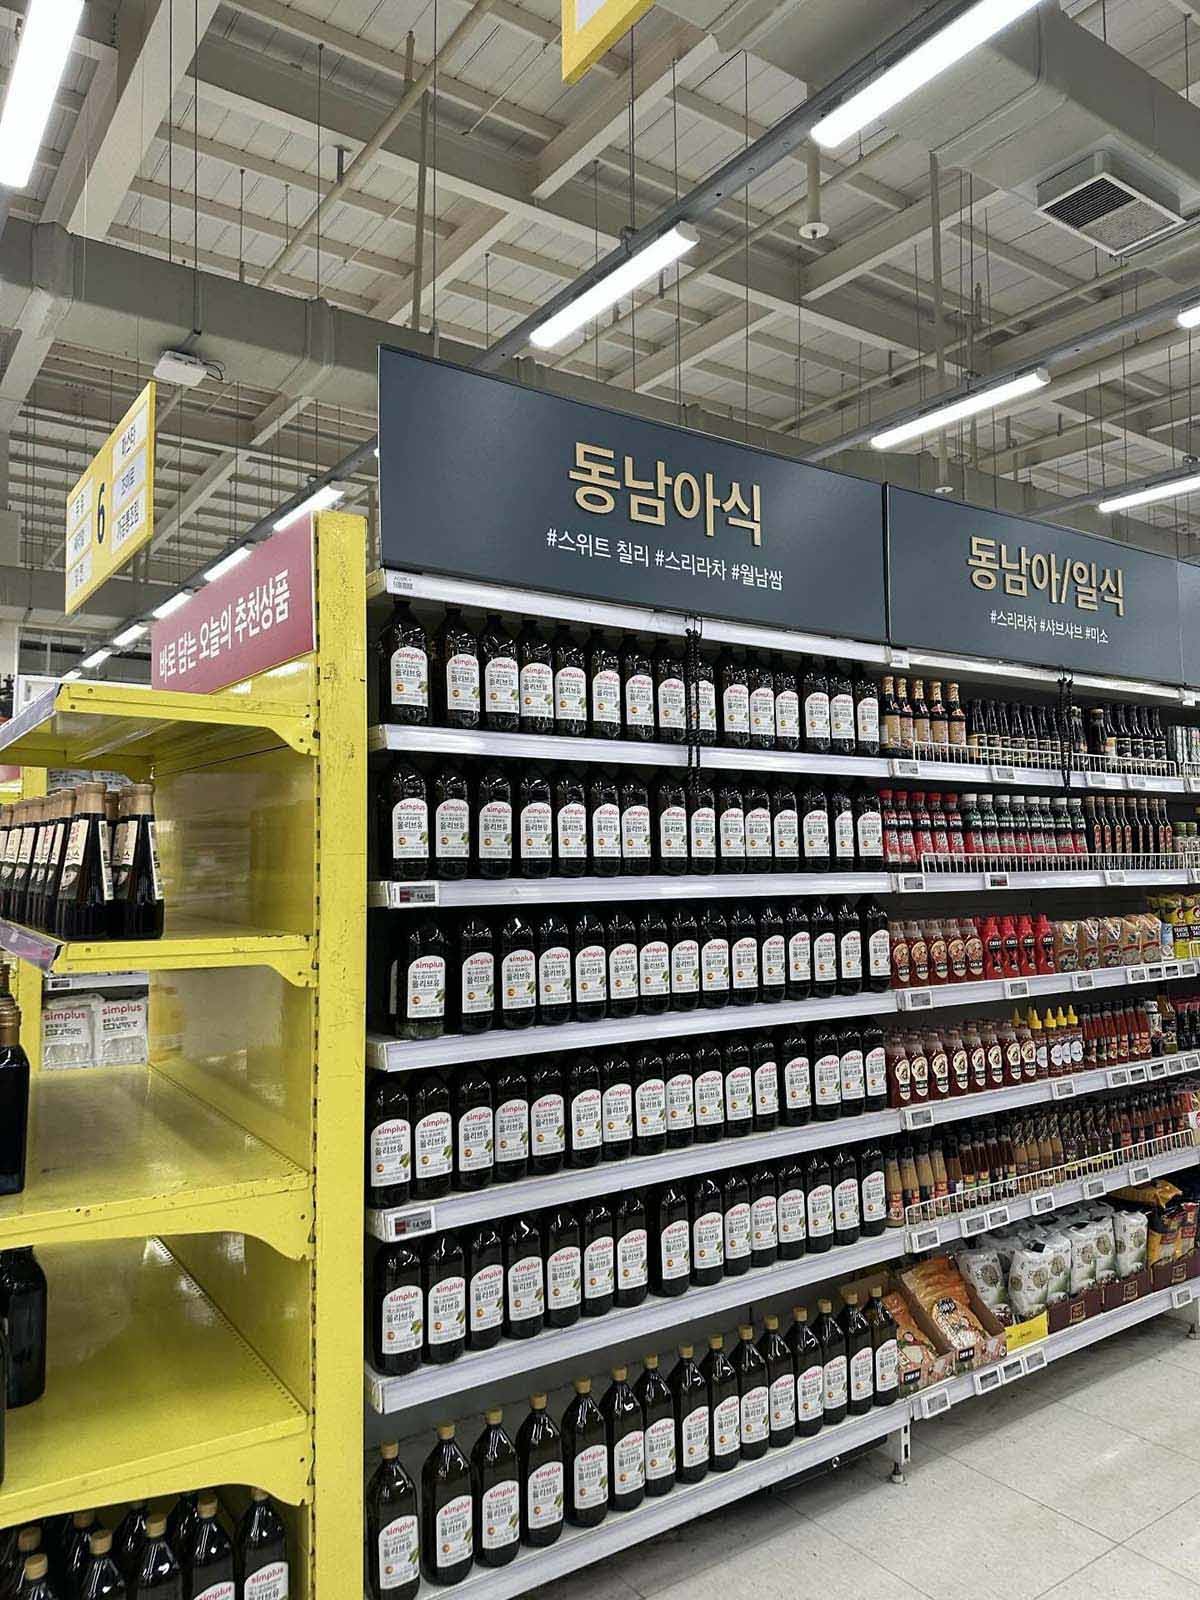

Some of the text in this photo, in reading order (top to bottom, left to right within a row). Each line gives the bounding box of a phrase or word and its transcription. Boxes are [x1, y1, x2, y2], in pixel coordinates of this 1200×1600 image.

[568, 441, 761, 547] 동남아식
[98, 483, 105, 544] 6
[547, 528, 783, 591] #스위트 칠리 #스리라차 #월남쌈
[968, 535, 1125, 617] 동남아/일식
[160, 569, 290, 683] 바로 담는 오늘의 추천상품
[990, 610, 1109, 645] #스리라차 #샤브샤브 #미소
[400, 802, 426, 810] simplus
[442, 803, 467, 812] simplus
[487, 806, 512, 814] simplus
[415, 961, 444, 969] simplus
[470, 958, 492, 966] simplus
[102, 1003, 142, 1015] simplus
[44, 1010, 86, 1021] simplus
[466, 1112, 491, 1121] simplus
[423, 1117, 450, 1128] simplus
[378, 1125, 407, 1135] simplus
[478, 1269, 502, 1281] simplus
[436, 1282, 463, 1293] simplus
[389, 1292, 418, 1302] simplus
[490, 1487, 516, 1498] simplus
[444, 1502, 470, 1515] simplus
[386, 1521, 415, 1536] simplus
[251, 1566, 284, 1584] simplus
